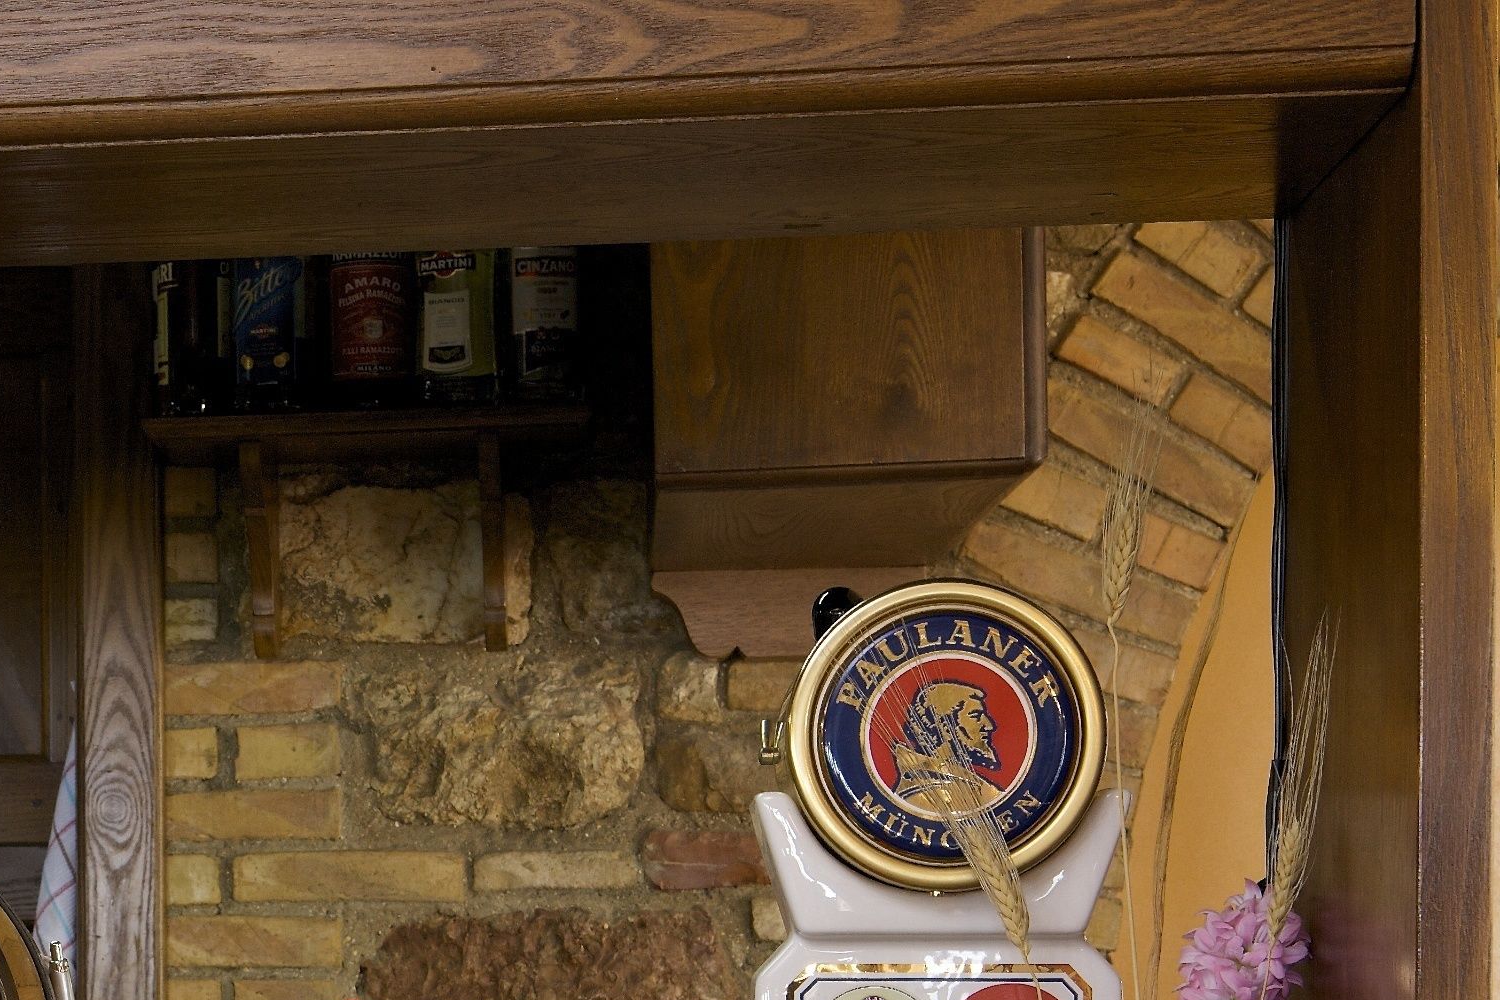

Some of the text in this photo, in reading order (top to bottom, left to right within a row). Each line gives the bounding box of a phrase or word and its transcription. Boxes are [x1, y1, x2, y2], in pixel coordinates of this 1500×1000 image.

[421, 258, 473, 272] MARTINI
[517, 260, 575, 273] CINZANO
[344, 276, 401, 294] AMARO
[836, 619, 1060, 713] PAULANER
[853, 790, 1043, 849] MÜNCEN
